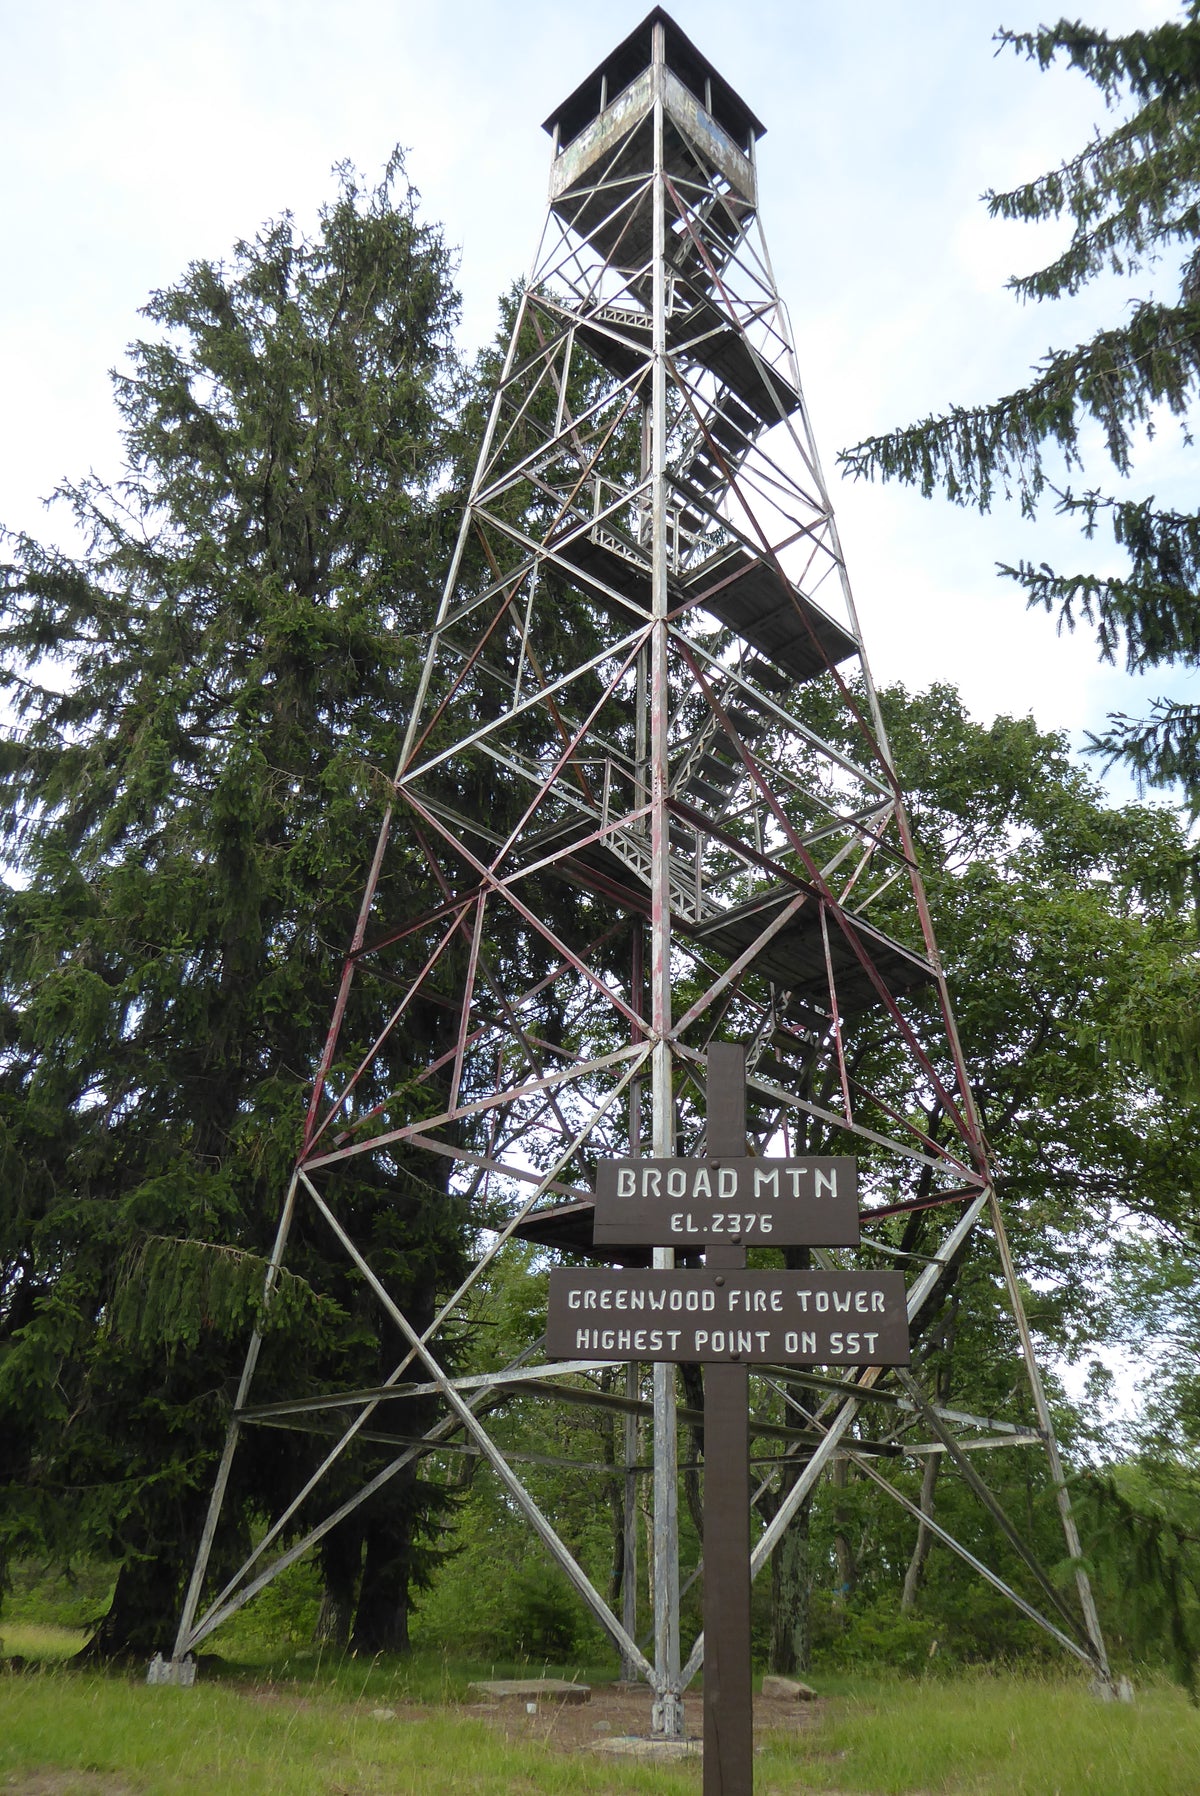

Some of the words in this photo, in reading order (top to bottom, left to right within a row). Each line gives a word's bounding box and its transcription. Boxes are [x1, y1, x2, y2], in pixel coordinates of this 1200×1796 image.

[616, 1167, 738, 1198] BROAD
[753, 1167, 838, 1198] MTN
[568, 1289, 716, 1312] GREENWOOD
[728, 1289, 784, 1312] FIRE
[796, 1290, 886, 1313] TOWER
[576, 1328, 682, 1351] HIGHEST
[694, 1329, 771, 1353] POINT
[784, 1331, 817, 1354] ON
[829, 1332, 879, 1355] SST
